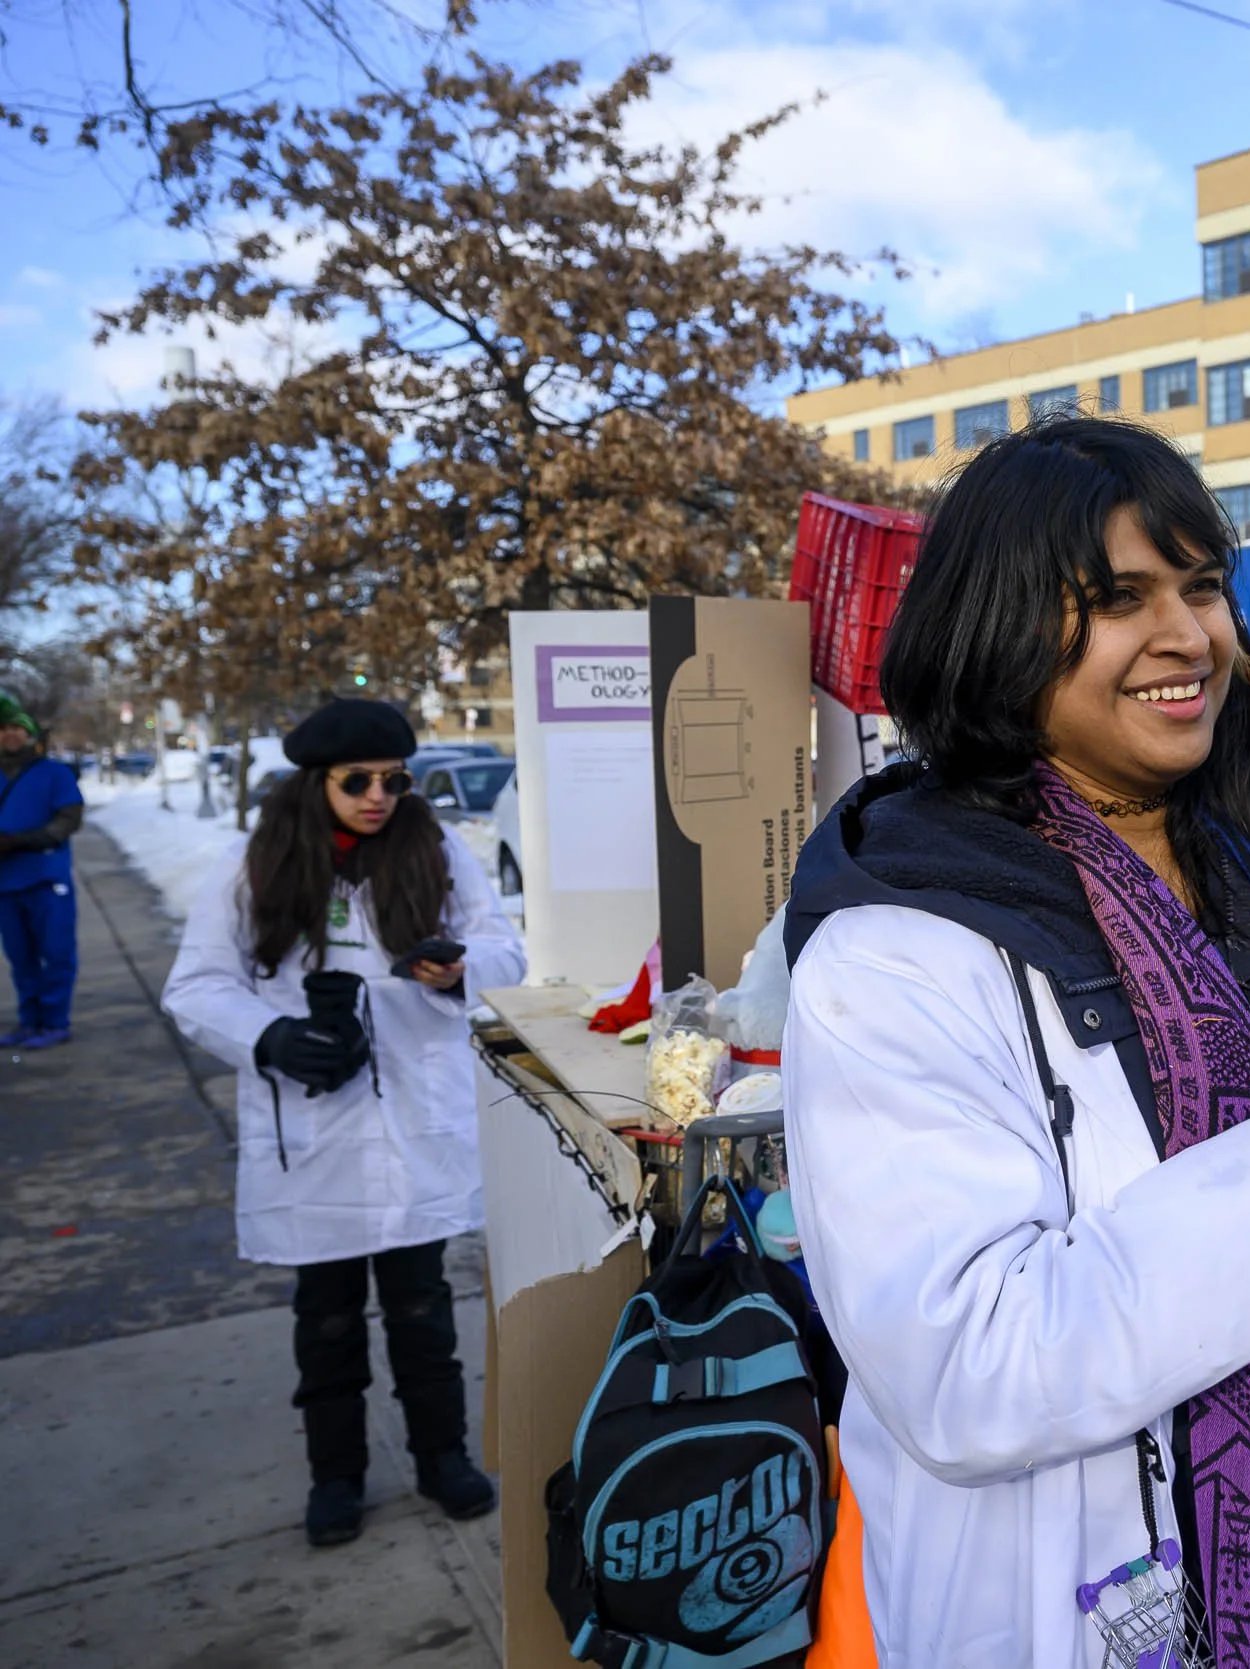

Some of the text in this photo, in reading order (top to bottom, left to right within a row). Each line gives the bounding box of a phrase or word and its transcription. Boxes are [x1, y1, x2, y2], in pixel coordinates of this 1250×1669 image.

[556, 665, 649, 681] METHOD-
[590, 684, 650, 699] OLOGY
[794, 746, 805, 813] battants
[762, 818, 775, 868] Board
[780, 808, 790, 903] entaciones
